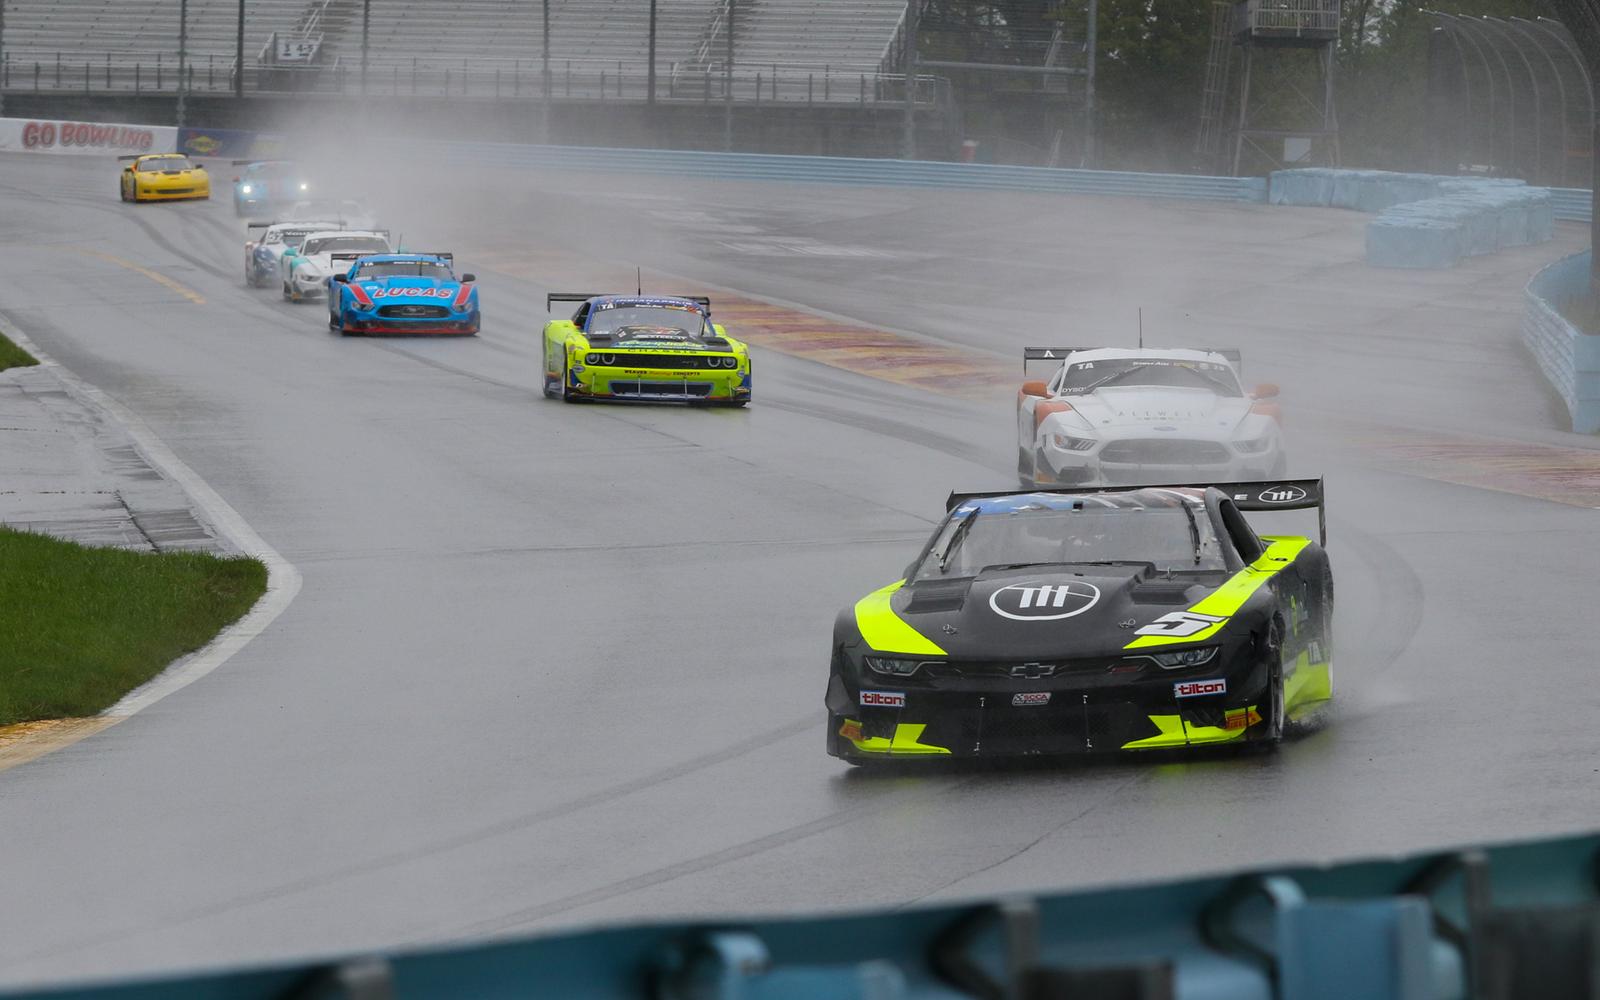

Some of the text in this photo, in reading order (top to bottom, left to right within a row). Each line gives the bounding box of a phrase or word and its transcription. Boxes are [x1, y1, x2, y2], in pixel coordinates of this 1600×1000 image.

[22, 121, 153, 149] GO BOWLING
[373, 287, 453, 298] LUCAS
[600, 302, 614, 310] TA
[1077, 362, 1094, 370] TA
[1178, 682, 1225, 695] tilton
[862, 693, 902, 705] tilton
